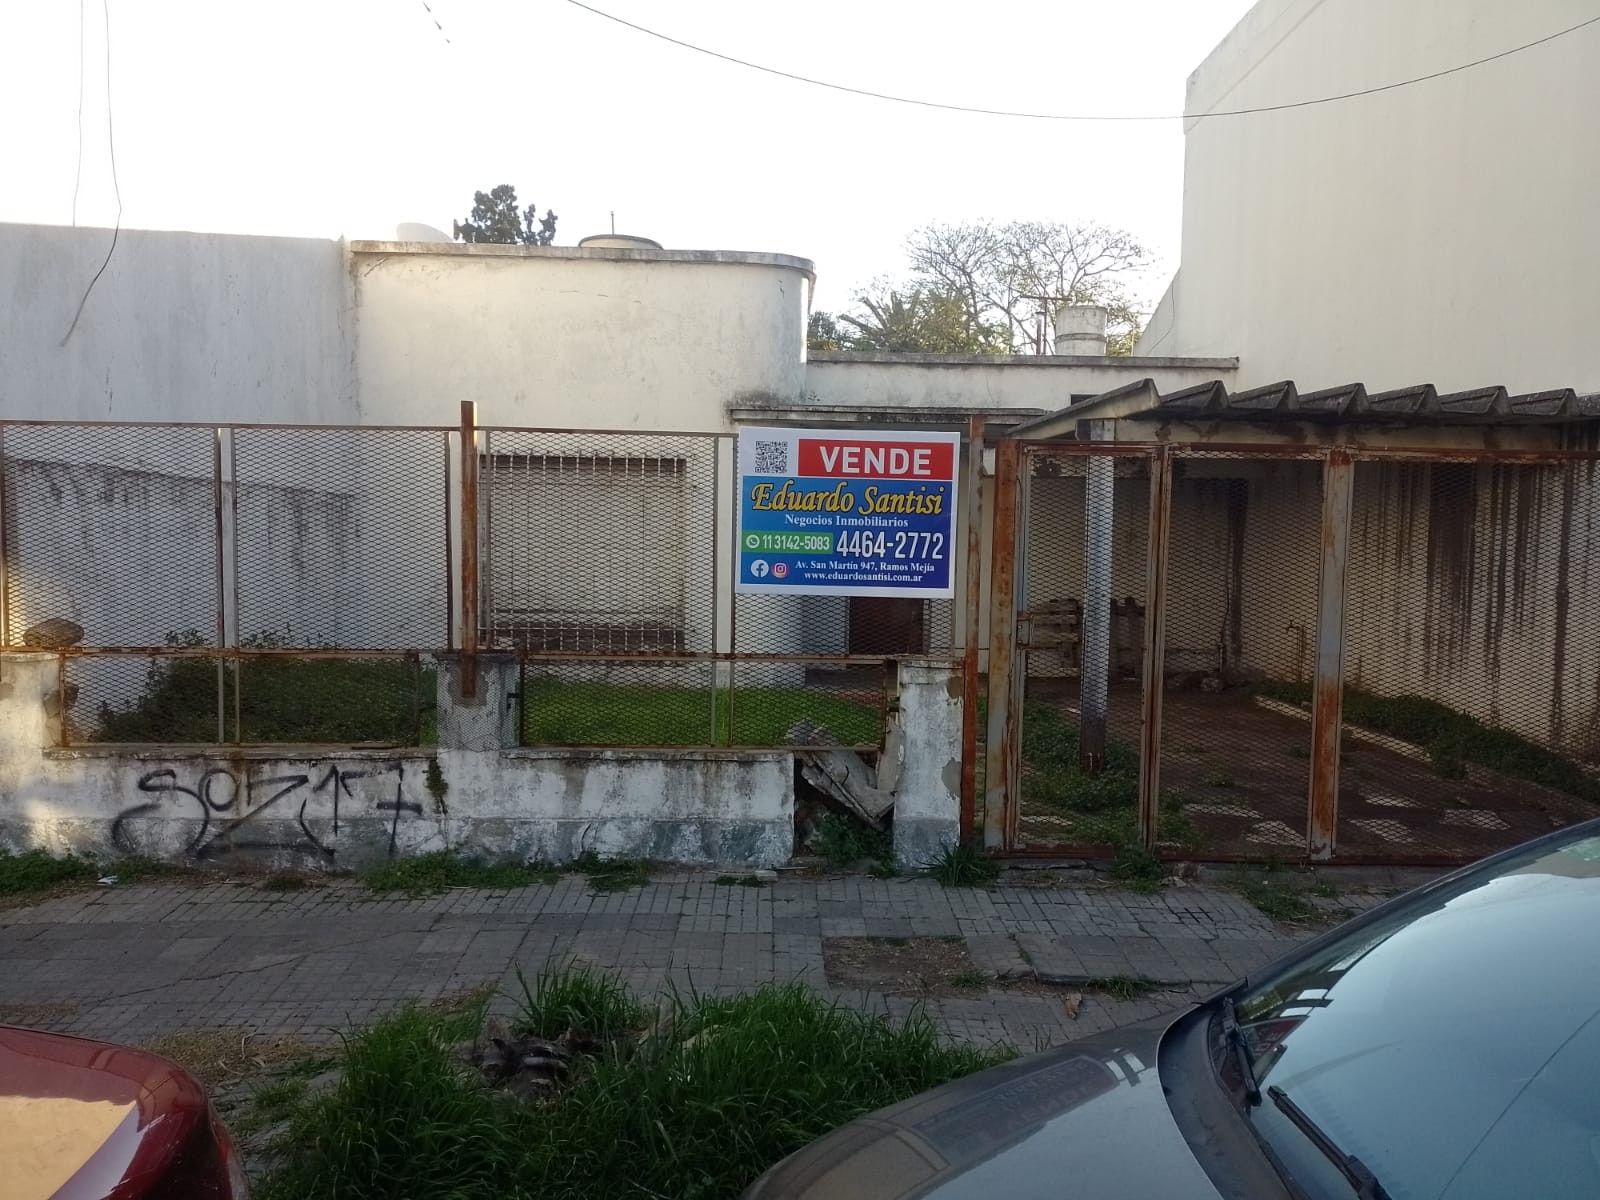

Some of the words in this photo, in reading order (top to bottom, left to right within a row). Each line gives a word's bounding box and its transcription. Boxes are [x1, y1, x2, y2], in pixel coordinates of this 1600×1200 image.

[819, 446, 932, 475] VENDE
[751, 479, 855, 513] Eduardo
[858, 485, 945, 515] Santisi
[785, 514, 833, 527] Negocios
[836, 515, 909, 528] Inmobiliarios
[836, 530, 944, 560] 4464-2772
[795, 560, 809, 569] Av.
[810, 561, 827, 569] San
[880, 562, 909, 572] Ramos
[910, 562, 935, 574] Mejía
[804, 571, 923, 582] www.eduardosantisi.com.ar
